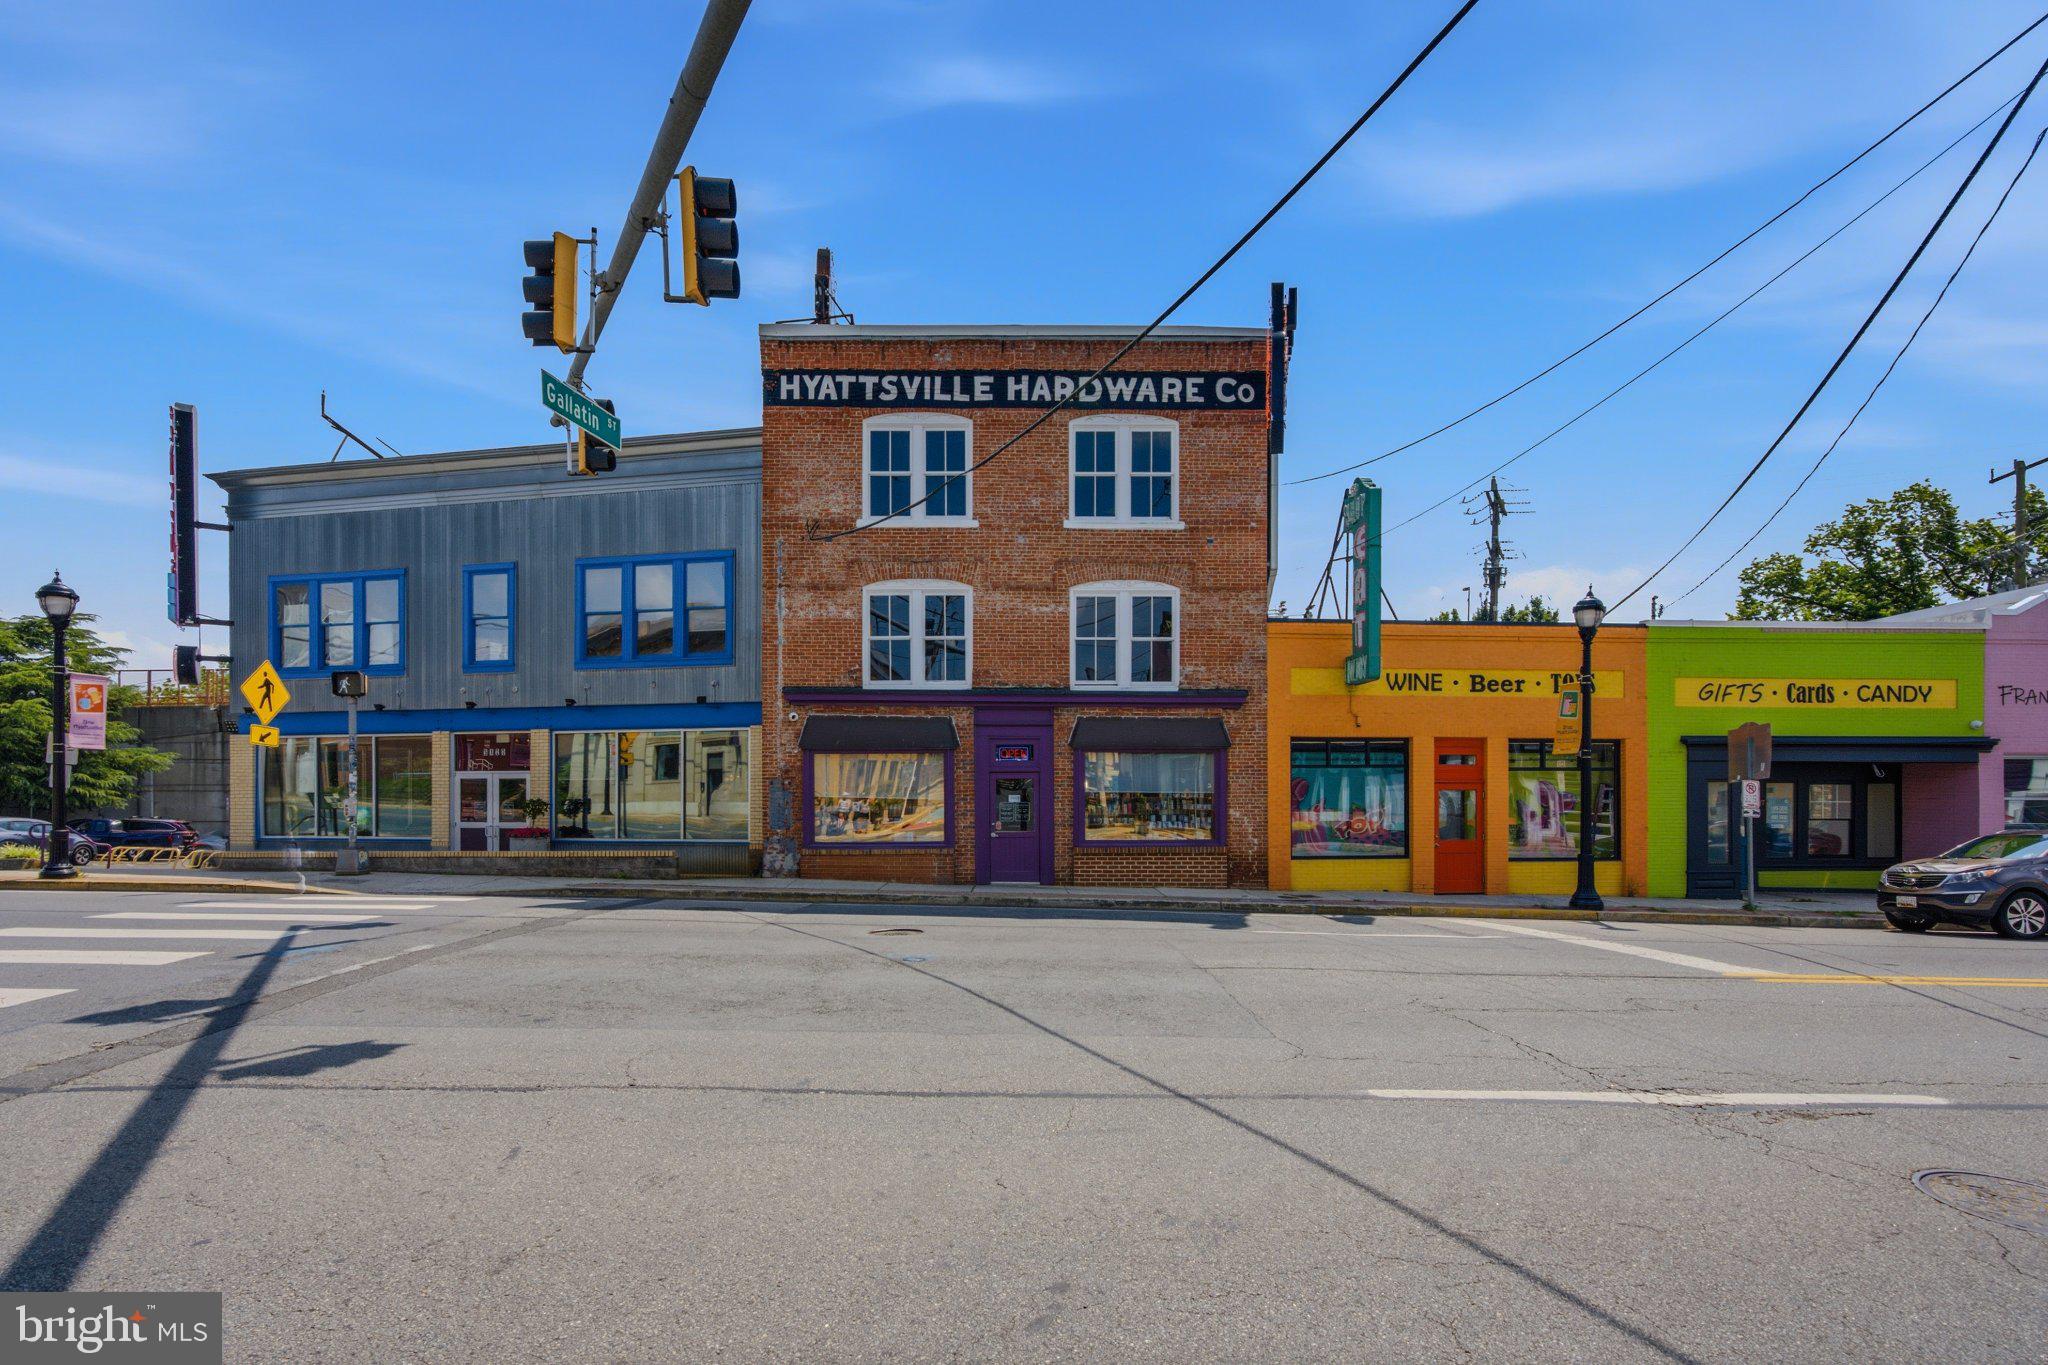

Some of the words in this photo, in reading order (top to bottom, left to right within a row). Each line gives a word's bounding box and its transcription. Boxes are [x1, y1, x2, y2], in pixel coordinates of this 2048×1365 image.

[779, 375, 994, 401] HYATTSVILLE
[1006, 375, 1205, 403] HARDWARE
[546, 382, 600, 431] Gallatin
[1385, 673, 1443, 692] WINE
[1469, 674, 1526, 693] Beer
[1698, 683, 1765, 703] GIFTS
[1786, 682, 1836, 705] Cards
[1856, 684, 1933, 704] CANDY
[1000, 748, 1027, 759] OPEN
